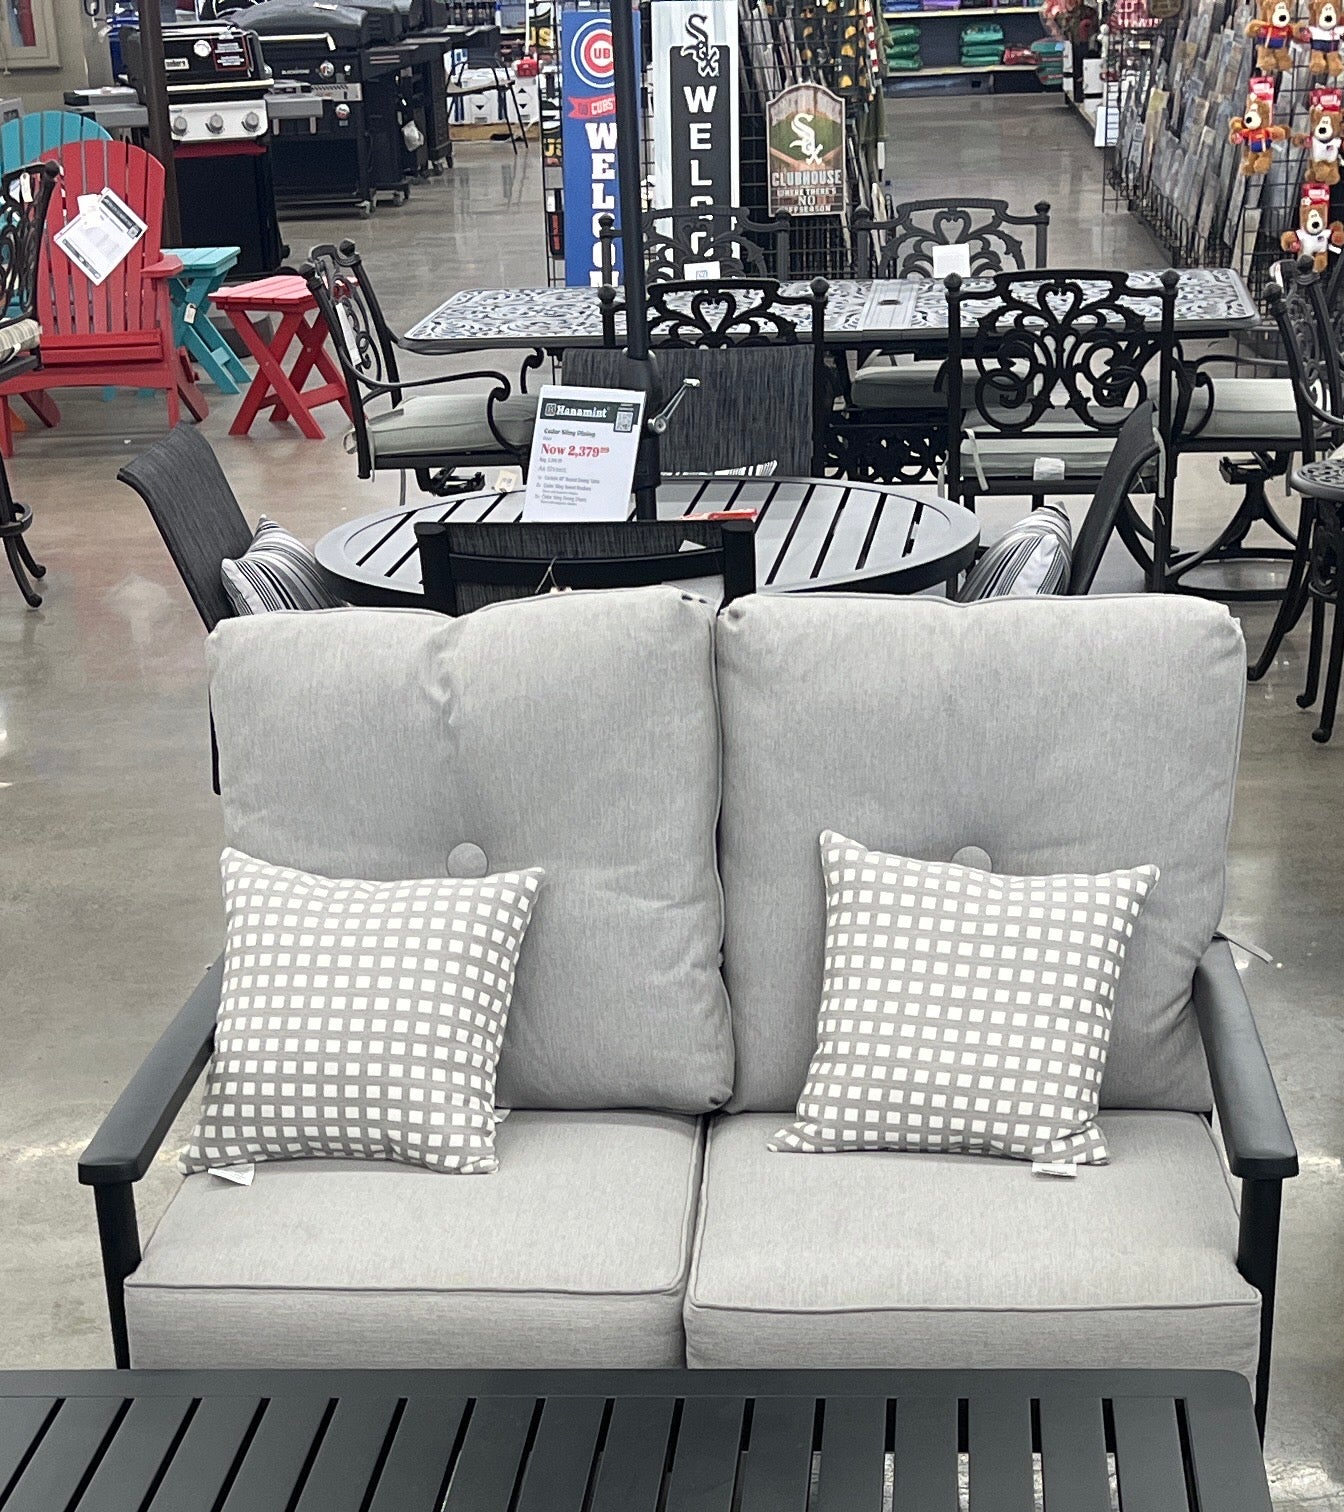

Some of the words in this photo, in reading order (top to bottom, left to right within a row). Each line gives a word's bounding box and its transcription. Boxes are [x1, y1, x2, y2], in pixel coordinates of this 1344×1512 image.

[771, 169, 842, 187] CLUBHOUSE
[798, 195, 816, 206] NO
[556, 404, 608, 418] Hanamint
[541, 443, 565, 455] Now
